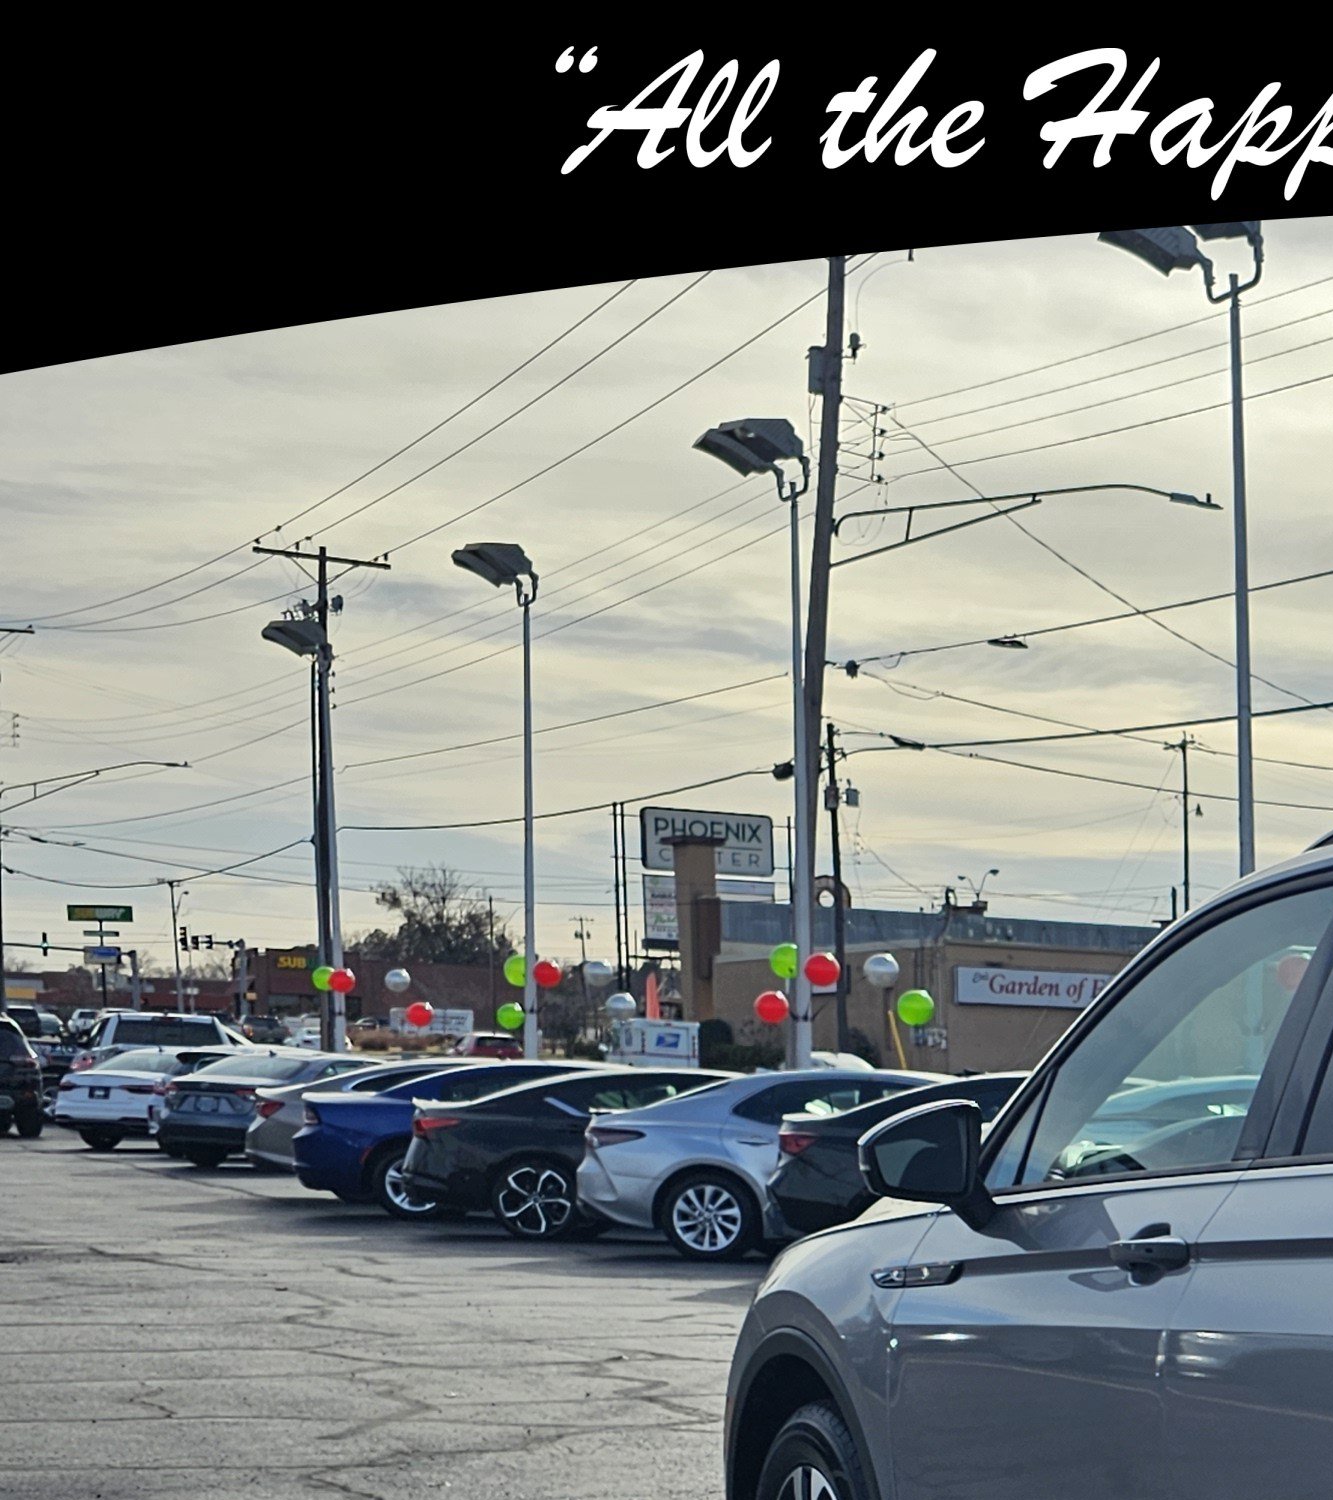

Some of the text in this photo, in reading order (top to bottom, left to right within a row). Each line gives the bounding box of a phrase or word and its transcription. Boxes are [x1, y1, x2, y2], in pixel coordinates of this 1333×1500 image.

[654, 817, 762, 843] PHOENIX
[658, 848, 760, 867] CTER
[277, 956, 314, 970] SUB
[989, 974, 1060, 997] Garden
[1066, 977, 1088, 1003] of
